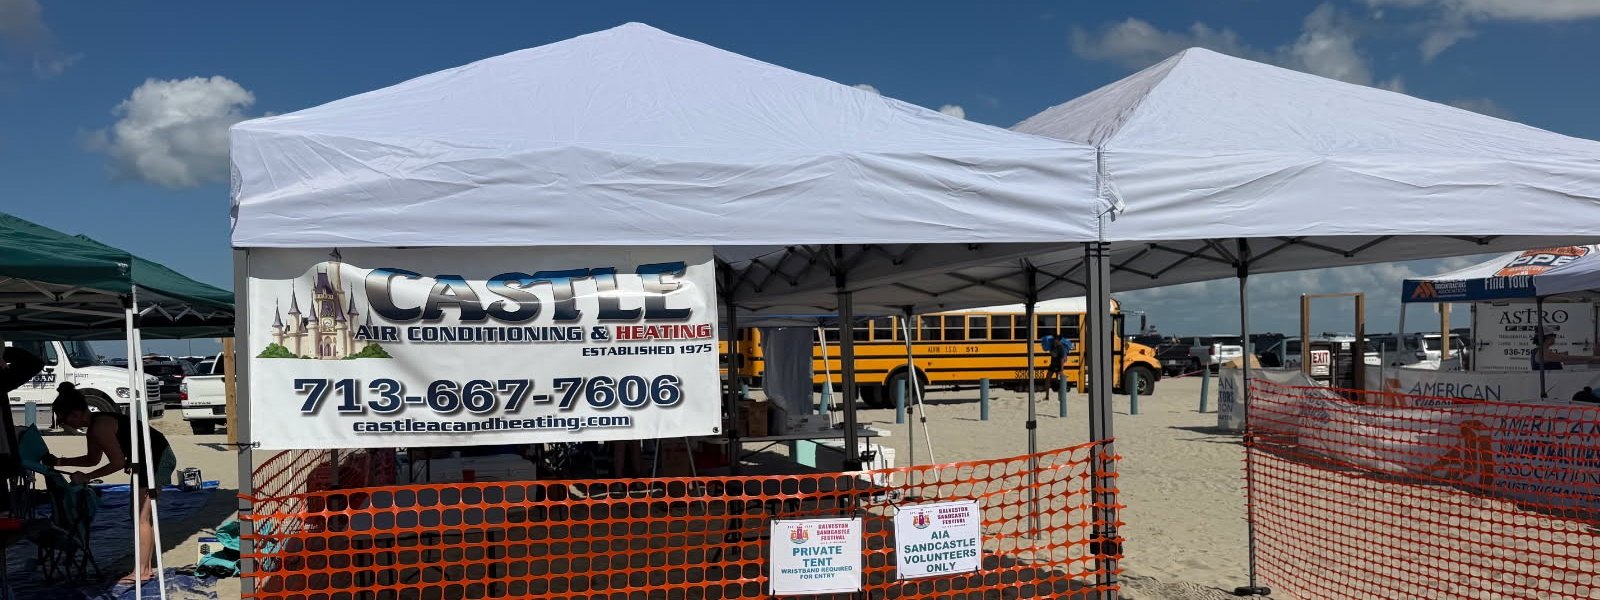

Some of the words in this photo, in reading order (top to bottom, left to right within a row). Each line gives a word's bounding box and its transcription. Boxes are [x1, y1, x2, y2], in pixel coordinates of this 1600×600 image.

[1484, 277, 1504, 290] Find
[365, 261, 691, 321] CASTLE
[1499, 309, 1568, 324] ASTRO
[354, 325, 398, 341] AIR
[408, 326, 582, 342] CONDITIONING
[591, 326, 608, 340] &
[616, 324, 711, 339] HEATING
[582, 346, 675, 356] ESTABLISHED
[680, 344, 712, 353] 1975
[1312, 352, 1329, 364] EXIT
[293, 374, 680, 413] 713-667-7606
[1408, 381, 1501, 401] AMERICAN
[352, 414, 631, 433] castleacandheating.com
[931, 530, 950, 540] AIA
[792, 546, 843, 557] PRIVATE
[904, 538, 976, 554] SANDCASTLE
[802, 557, 833, 568] TENT
[904, 549, 977, 564] VOLUNTEERS
[926, 562, 956, 573] ONLY
[814, 572, 835, 580] ENTRY
